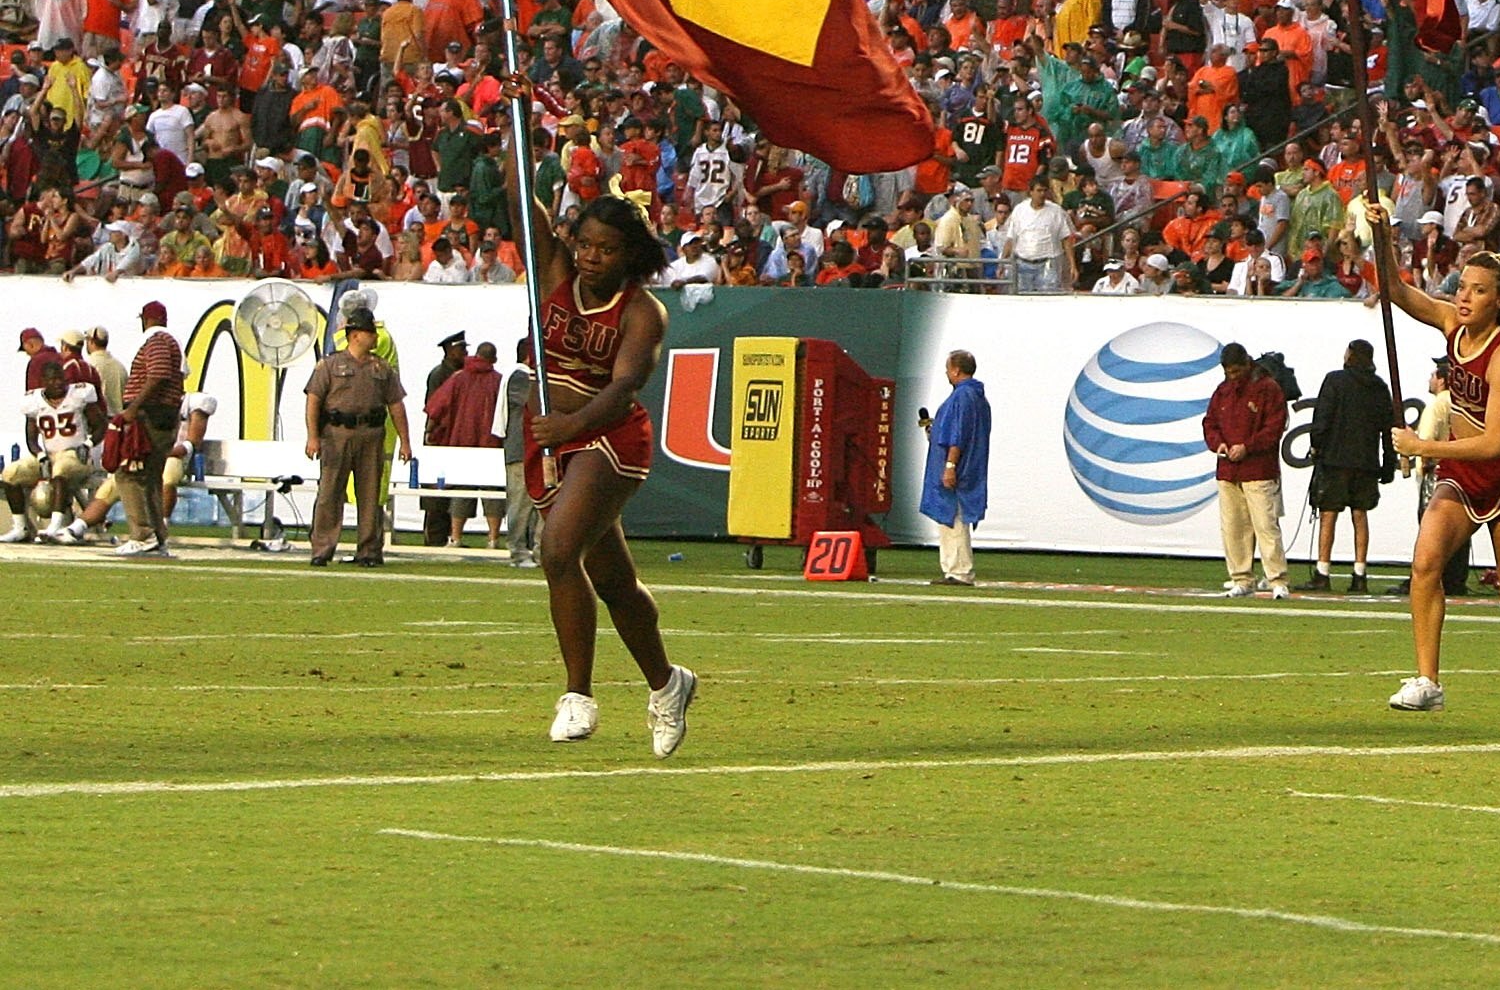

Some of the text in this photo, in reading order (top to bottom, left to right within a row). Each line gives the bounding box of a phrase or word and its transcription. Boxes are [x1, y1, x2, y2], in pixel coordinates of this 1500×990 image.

[963, 123, 985, 144] 81
[1008, 144, 1030, 163] 12
[543, 302, 618, 360] FSU
[746, 389, 780, 422] SUN
[38, 412, 77, 439] 93
[743, 426, 776, 439] SPORTS
[810, 537, 852, 574] 20
